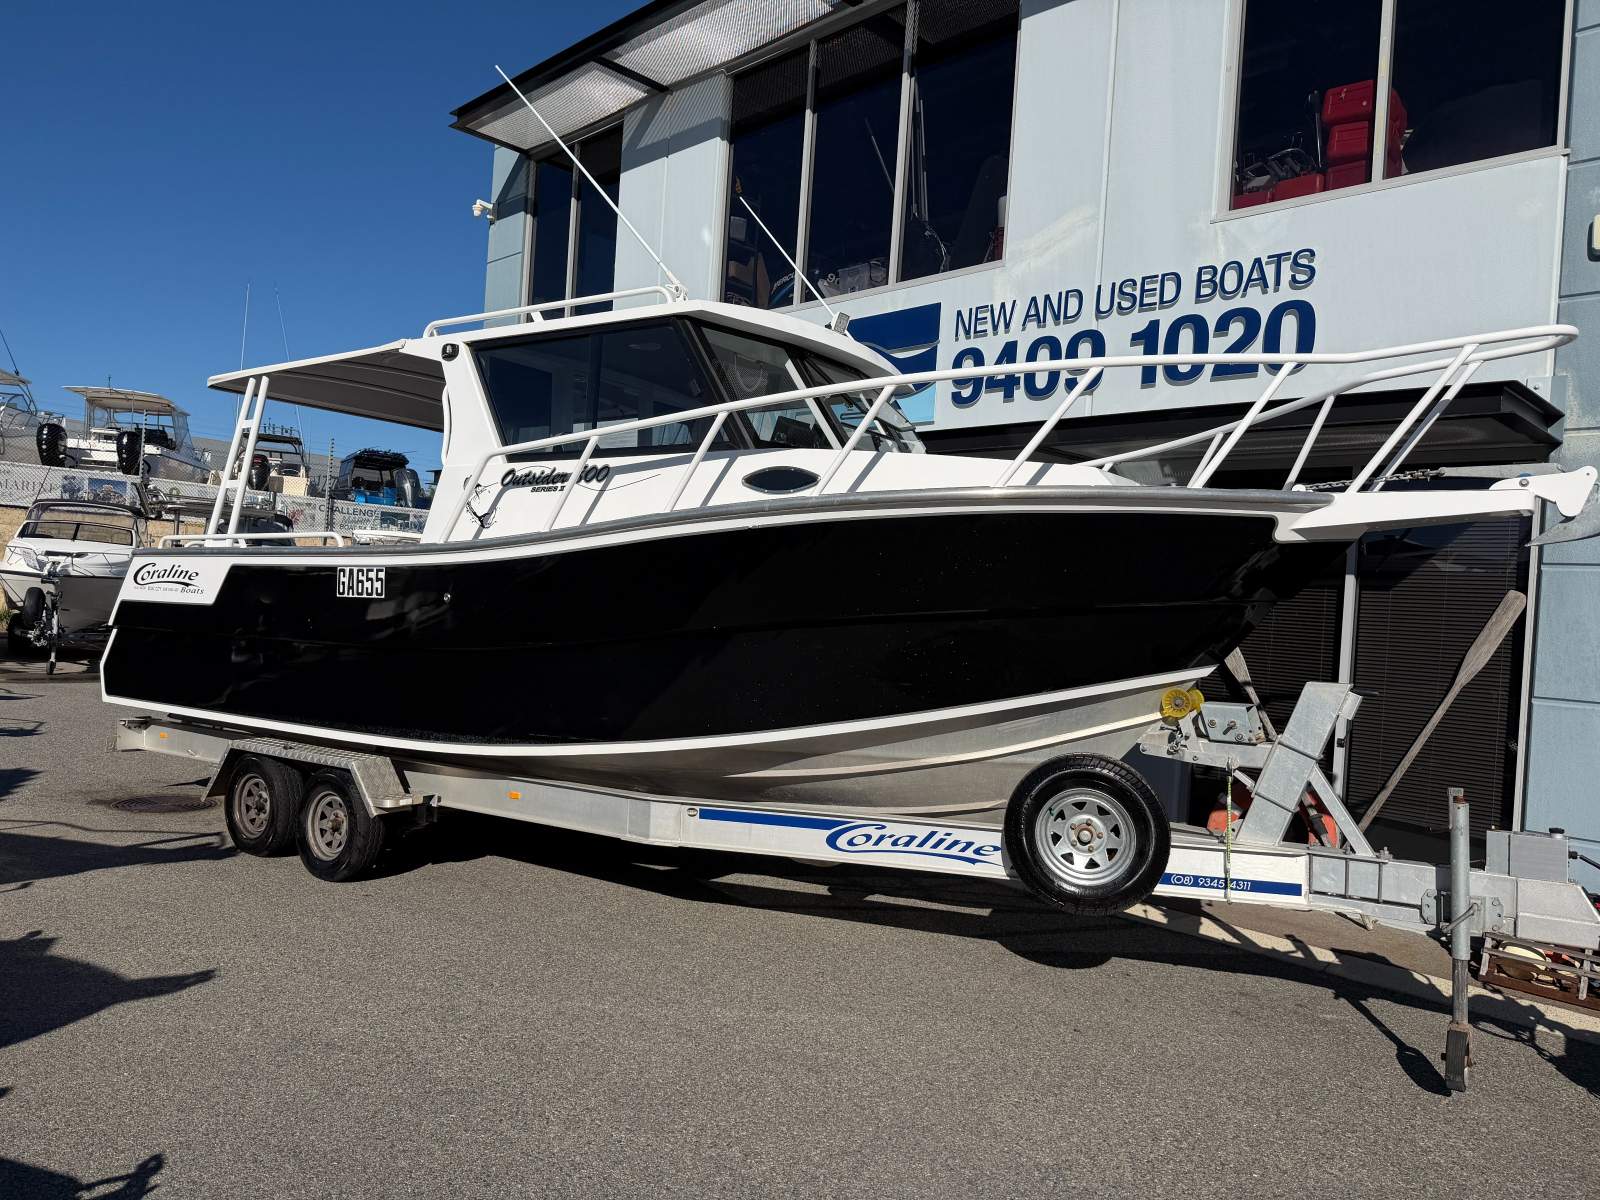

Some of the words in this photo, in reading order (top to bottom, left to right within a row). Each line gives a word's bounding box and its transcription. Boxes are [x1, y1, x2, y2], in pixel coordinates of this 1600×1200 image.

[955, 300, 1016, 341] NEW
[1021, 288, 1084, 330] AND
[1095, 271, 1182, 320] USED
[1194, 248, 1317, 305] BOATS
[951, 329, 1106, 408] 9409
[1130, 299, 1317, 390] 1020
[501, 466, 573, 487] Outsider
[133, 562, 199, 586] Coraline
[337, 567, 385, 597] GA655
[180, 586, 204, 595] Boats
[826, 823, 1002, 859] Coraline
[1171, 874, 1194, 886] (08)
[1198, 877, 1225, 889] 9345
[1229, 880, 1251, 891] 4311
